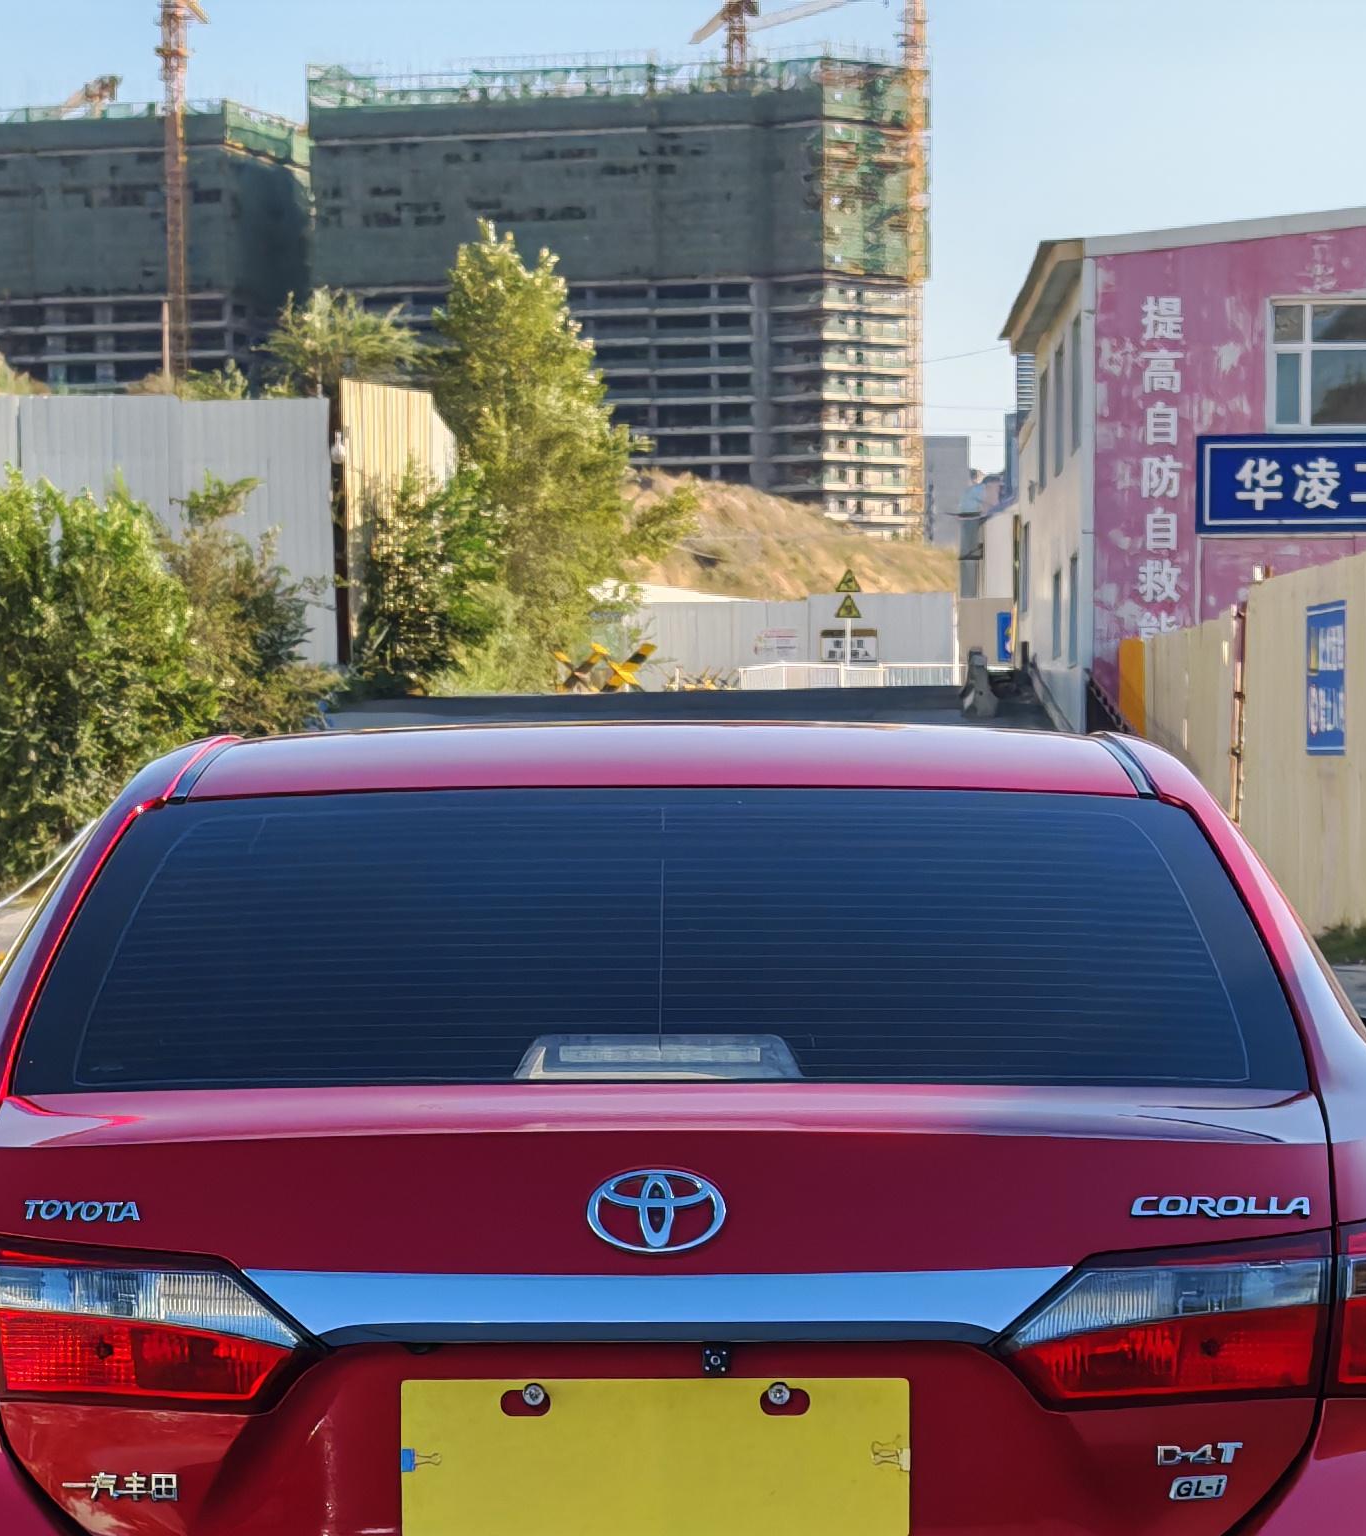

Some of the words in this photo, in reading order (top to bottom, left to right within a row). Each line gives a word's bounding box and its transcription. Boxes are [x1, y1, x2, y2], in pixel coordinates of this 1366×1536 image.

[24, 1199, 141, 1222] TOYOTA
[1131, 1196, 1311, 1219] COROLLA
[61, 1471, 178, 1501] 一汽丰田
